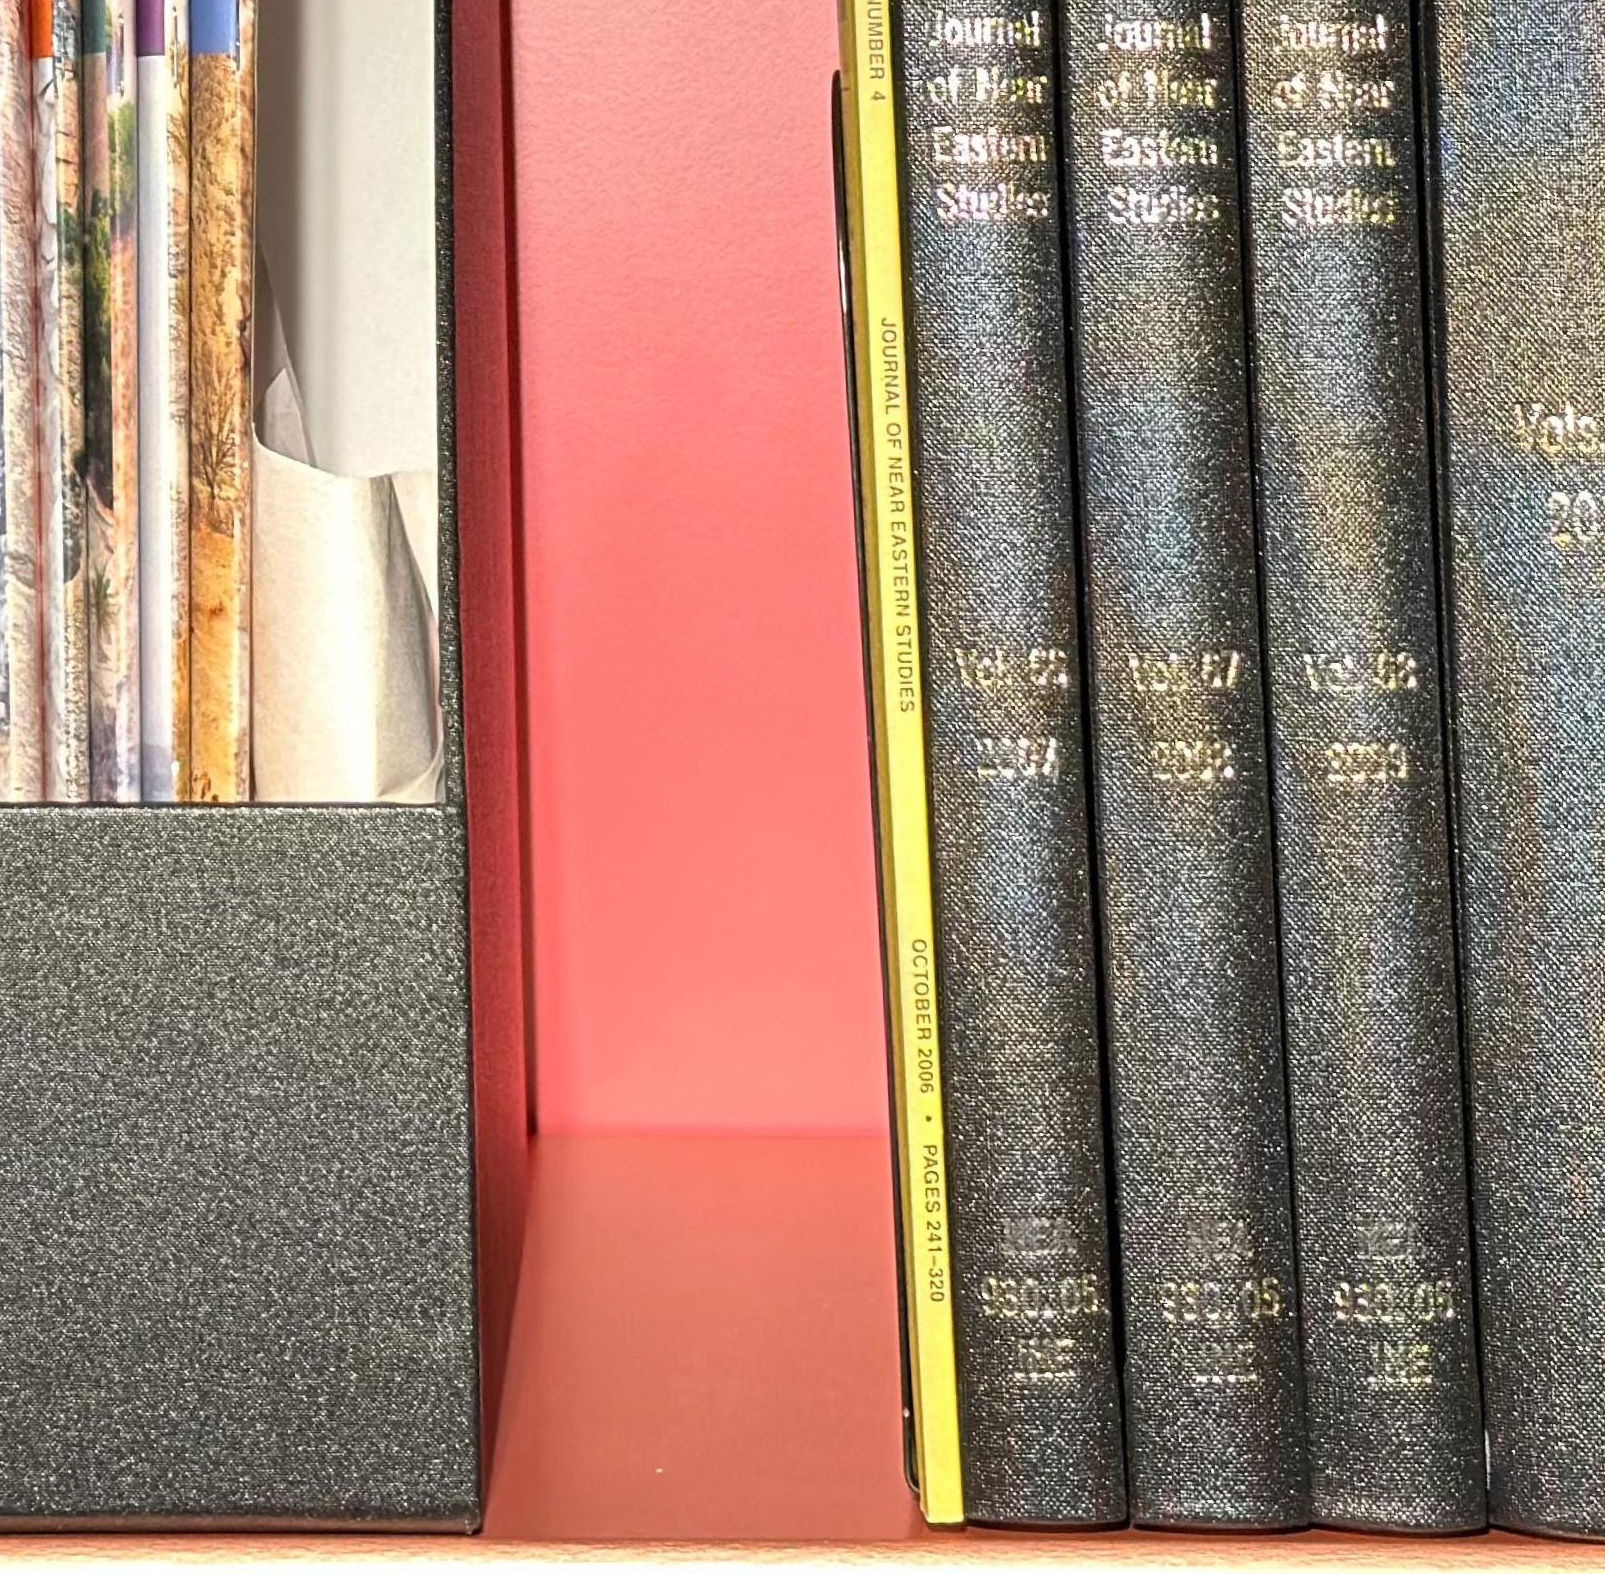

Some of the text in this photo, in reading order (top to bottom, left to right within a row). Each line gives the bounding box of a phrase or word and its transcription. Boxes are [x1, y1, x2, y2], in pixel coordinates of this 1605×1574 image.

[928, 10, 1041, 48] Journal
[1097, 12, 1213, 50] Journal
[1273, 13, 1387, 52] Journal
[870, 91, 887, 102] 4
[928, 65, 1048, 104] of Near
[1096, 68, 1218, 109] of Near
[1272, 68, 1397, 111] of Near
[933, 125, 1048, 164] Eastern
[1102, 128, 1218, 167] Eastern
[1277, 130, 1396, 168] Eastern
[936, 184, 1048, 224] Studies
[1107, 185, 1221, 226] Studies
[1280, 185, 1397, 226] Studies
[880, 318, 915, 713] JOURNAL OF NEAR EASTERN STUDIES
[911, 939, 931, 1040] OCTOBER
[916, 1048, 934, 1094] 2006
[922, 1145, 941, 1213] PAGES
